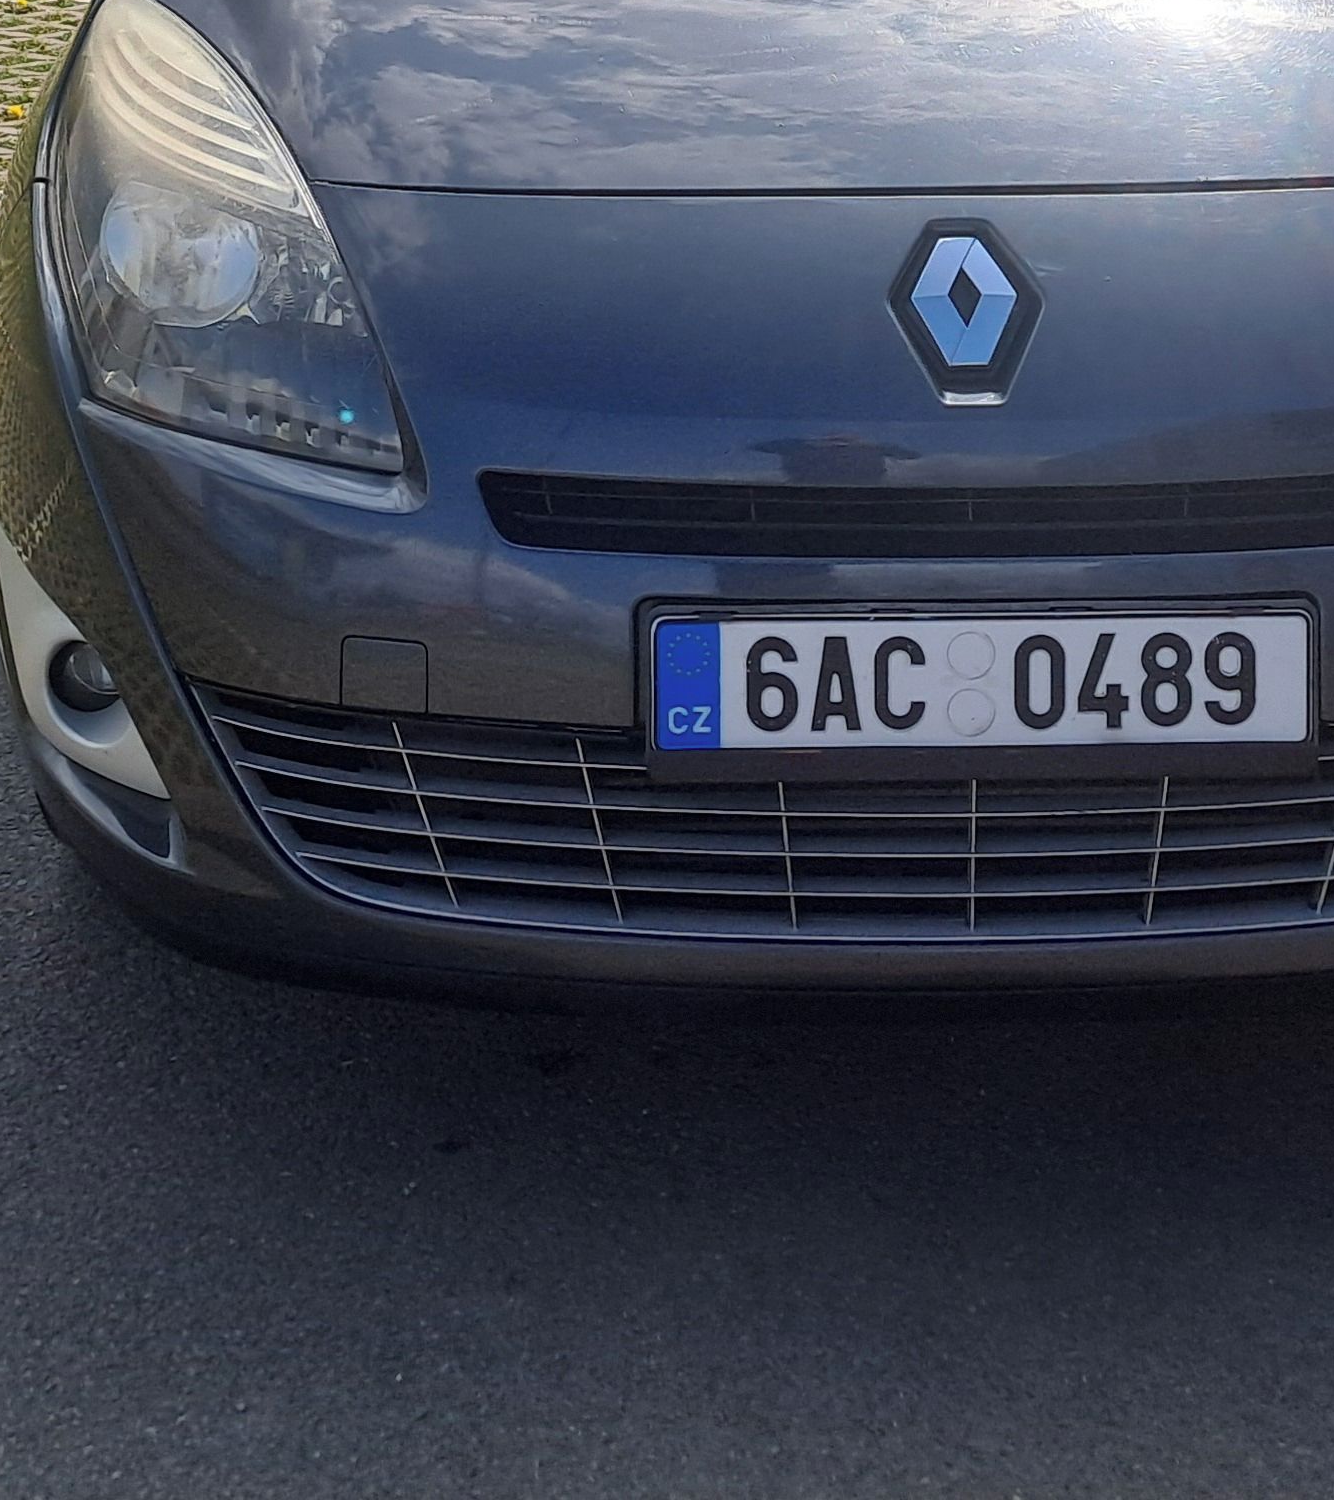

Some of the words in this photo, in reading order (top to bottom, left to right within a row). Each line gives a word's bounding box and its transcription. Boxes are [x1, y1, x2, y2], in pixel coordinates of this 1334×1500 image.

[746, 635, 926, 732] 6AC
[1013, 631, 1257, 730] 0489
[668, 706, 712, 734] CZ
